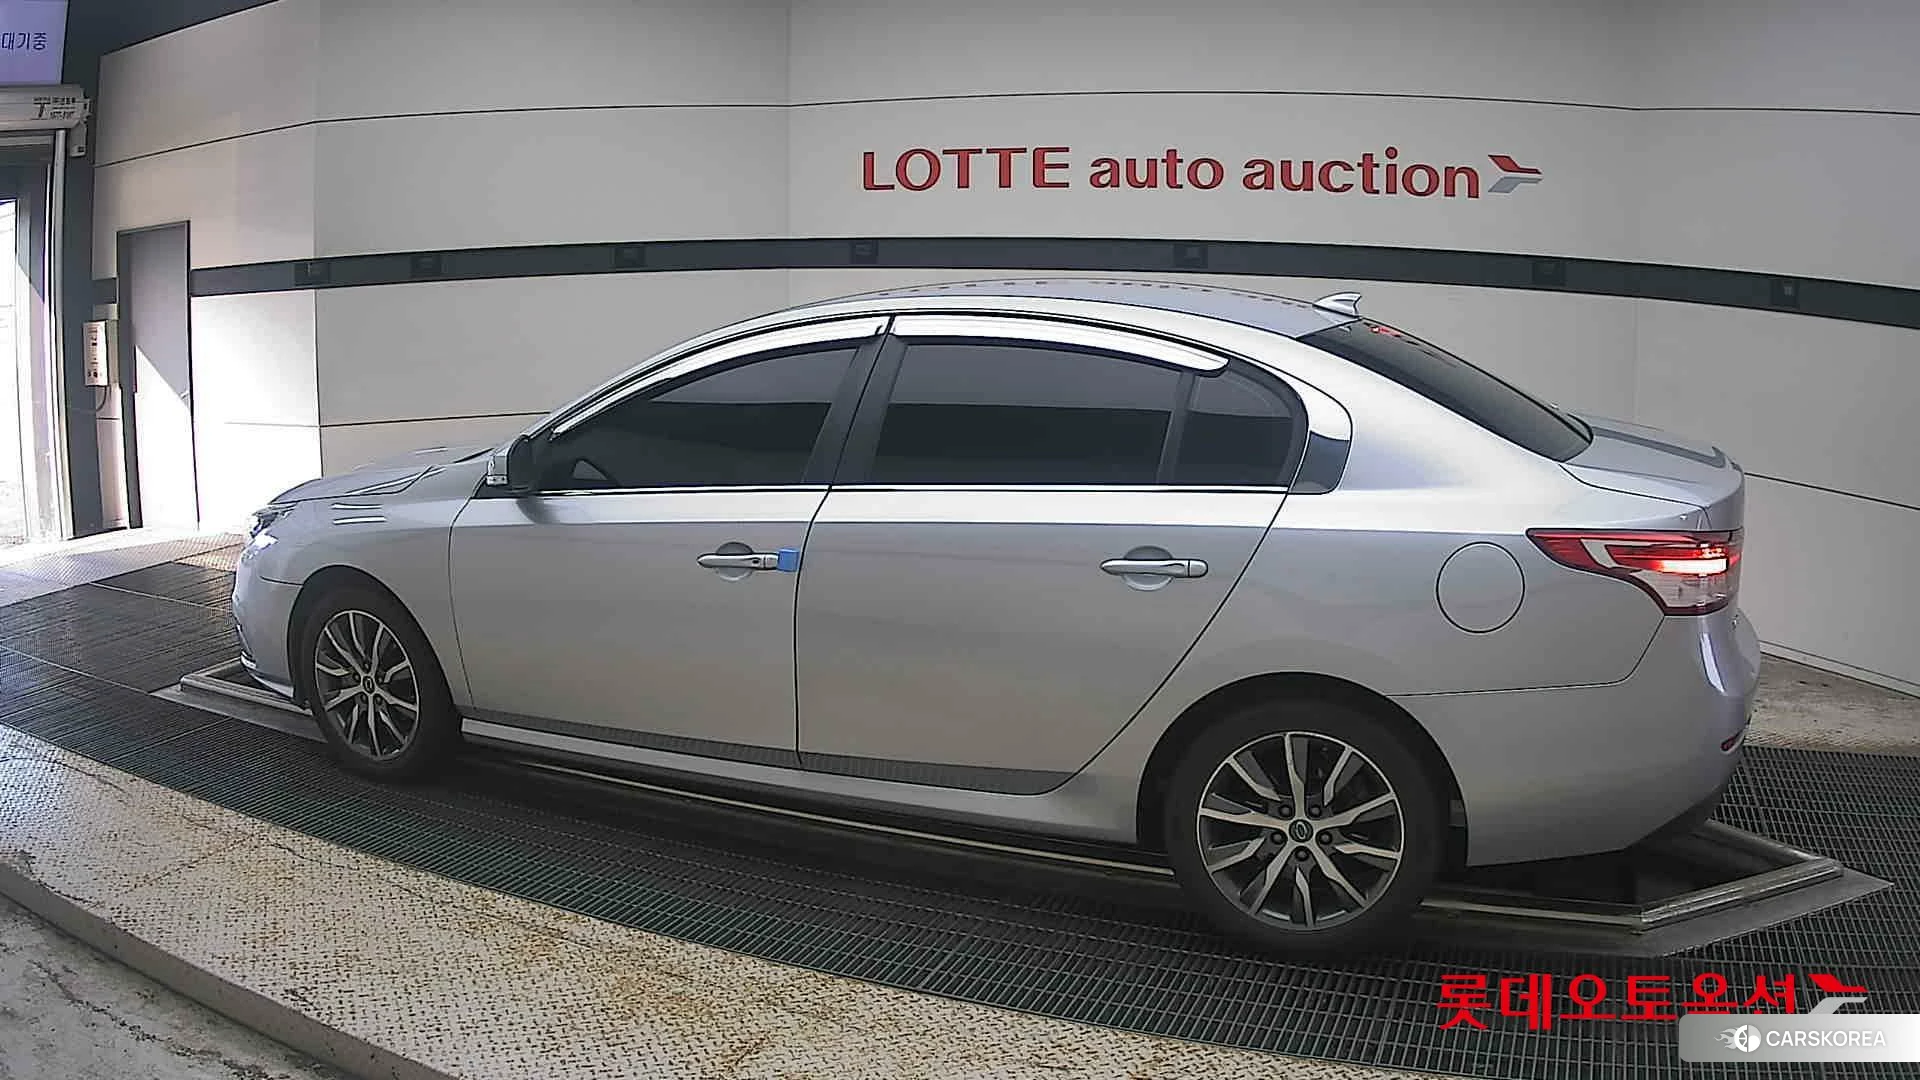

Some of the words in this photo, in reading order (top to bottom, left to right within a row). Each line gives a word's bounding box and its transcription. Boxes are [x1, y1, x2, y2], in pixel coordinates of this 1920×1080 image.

[1, 32, 48, 51] 대기중
[863, 147, 1069, 191] LOTTE
[1089, 149, 1224, 189] auto
[1242, 146, 1479, 198] auction
